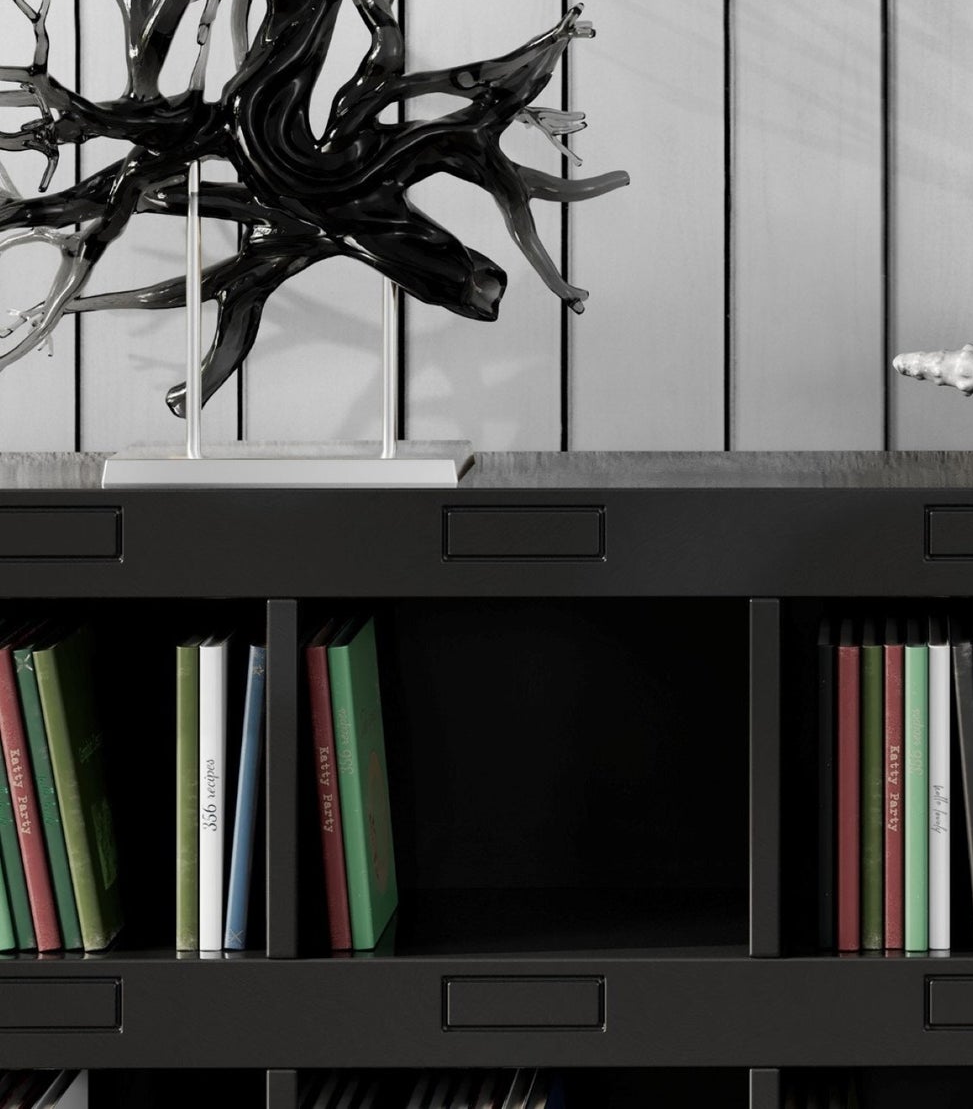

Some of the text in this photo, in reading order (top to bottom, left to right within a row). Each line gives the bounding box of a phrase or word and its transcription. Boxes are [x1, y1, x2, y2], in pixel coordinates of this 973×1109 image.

[10, 748, 32, 835] Katty Party
[202, 759, 220, 832] 356 recipes
[319, 746, 336, 834] Katty Party
[888, 745, 900, 832] Katty Party
